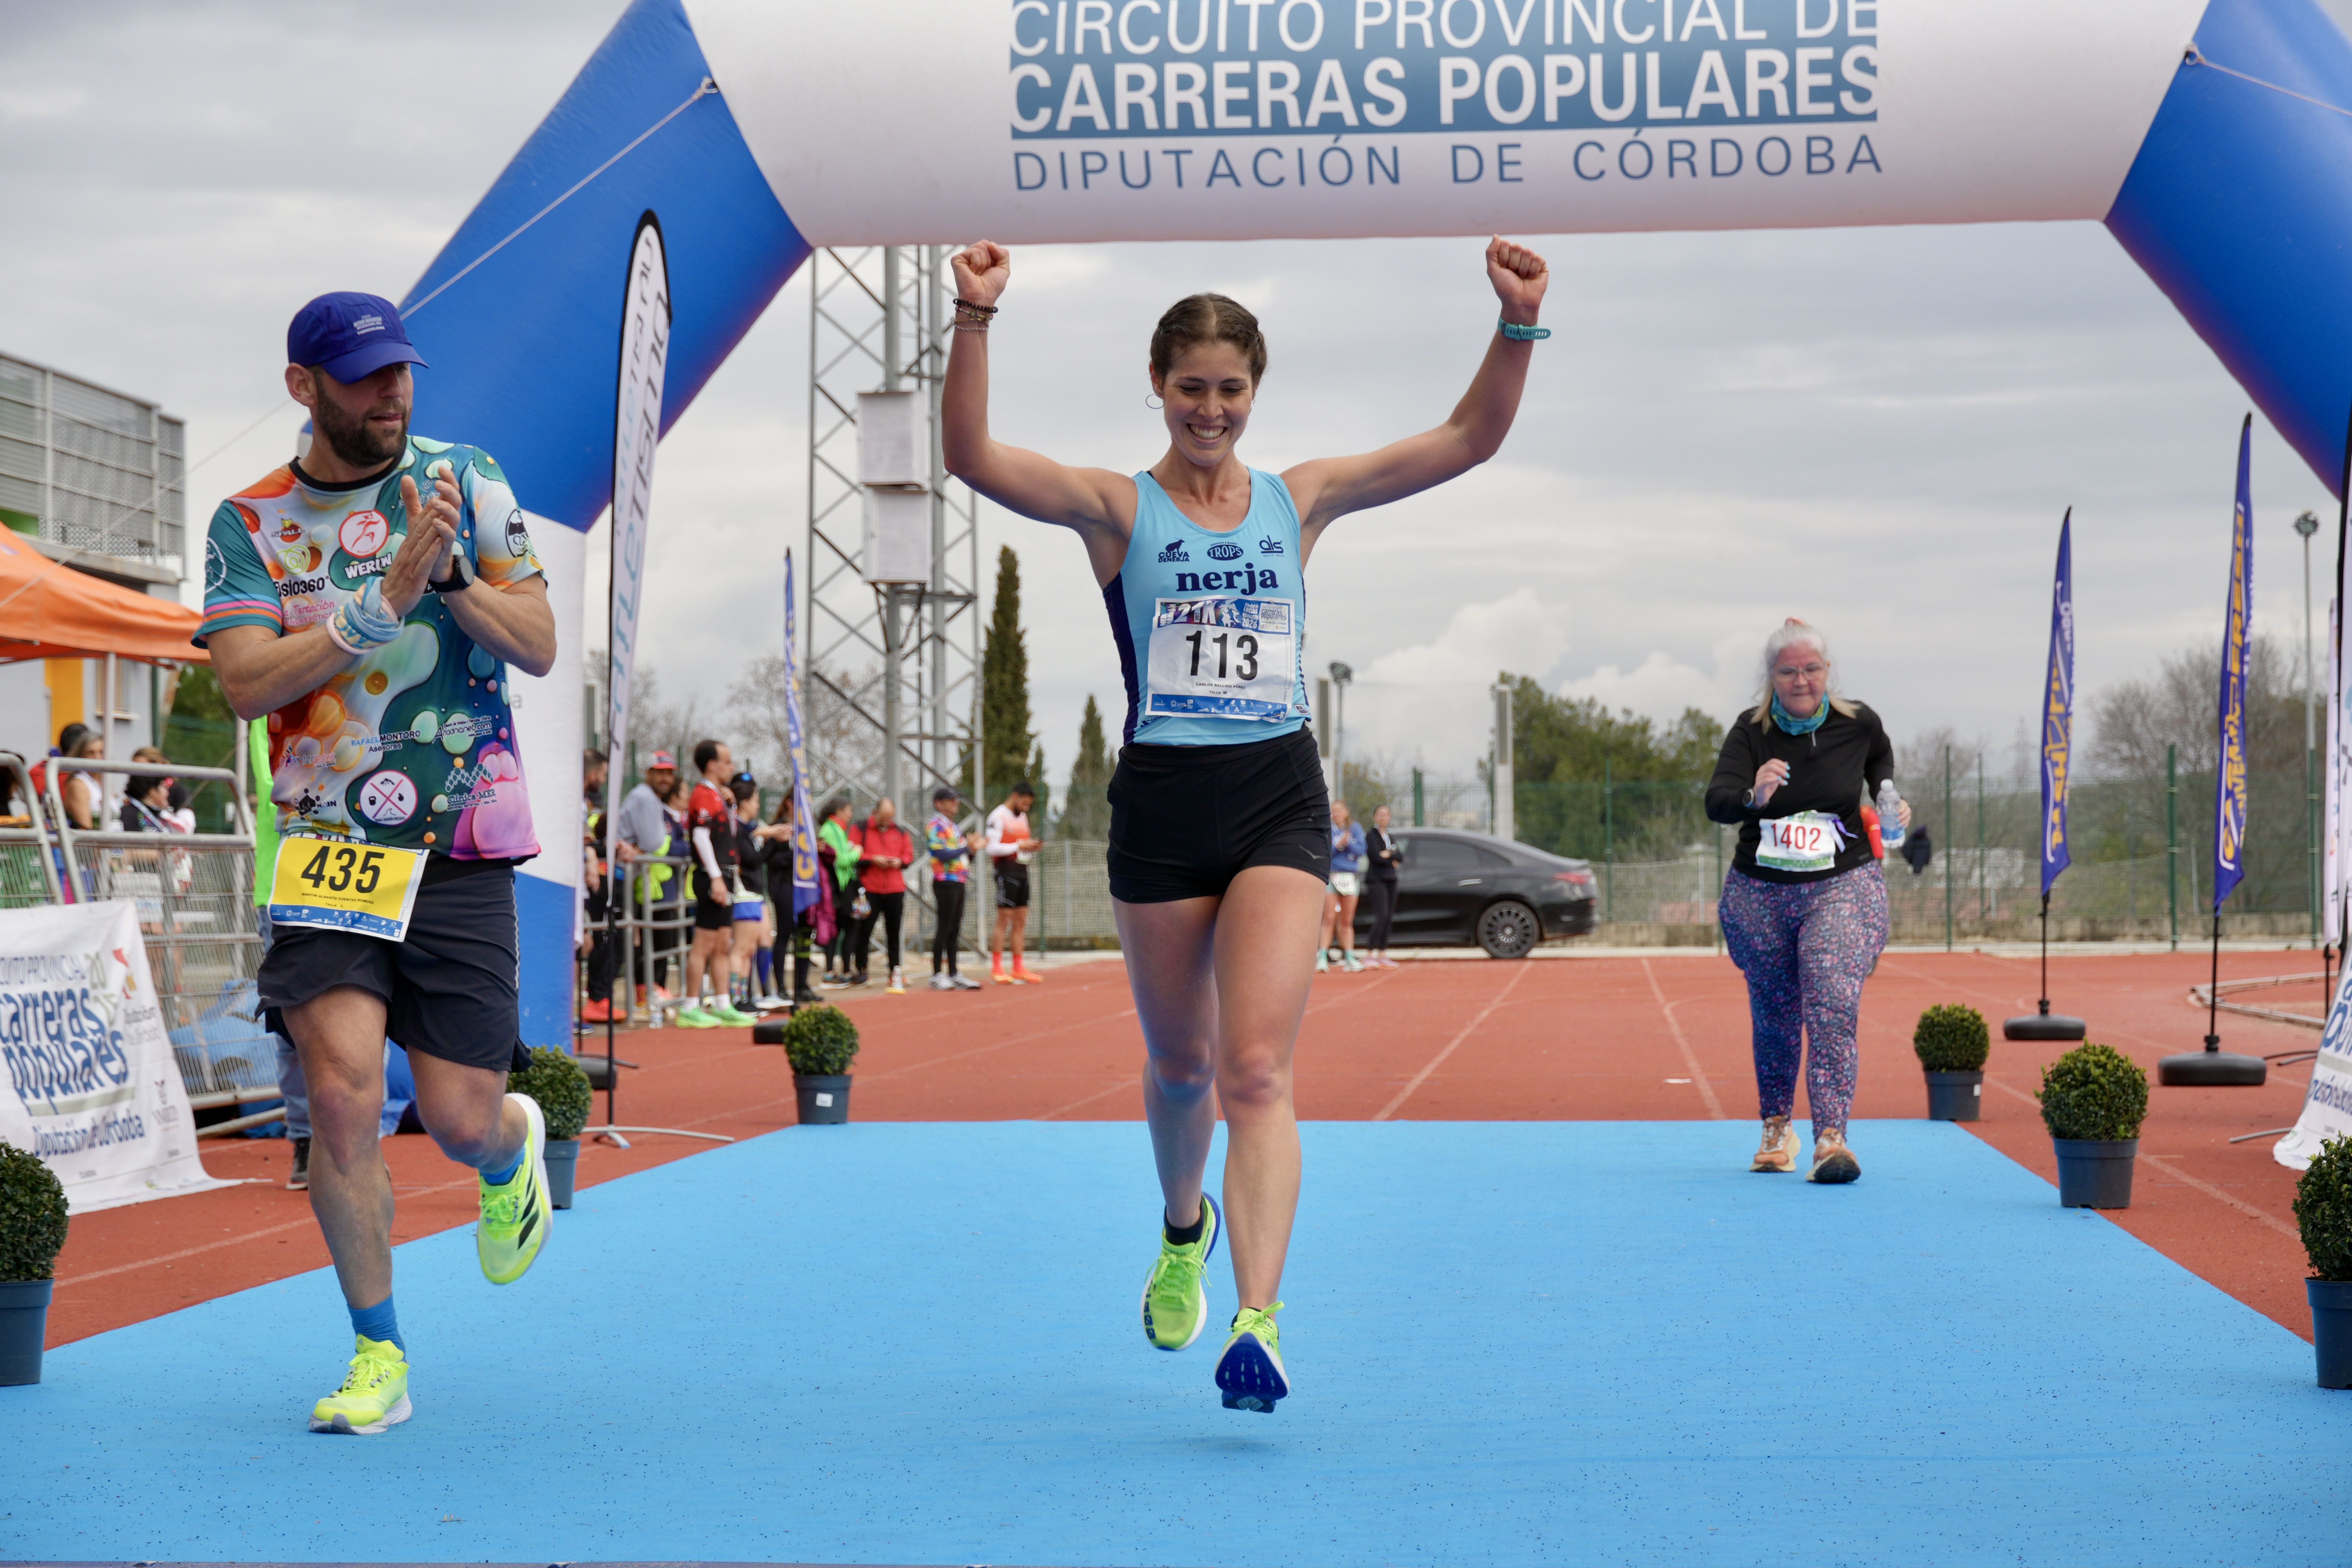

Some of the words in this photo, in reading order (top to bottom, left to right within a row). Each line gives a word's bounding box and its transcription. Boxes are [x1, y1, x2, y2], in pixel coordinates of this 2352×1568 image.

[1010, 0, 1324, 56] CIRCUITO
[1355, 0, 1767, 49] PROVINCIAL
[1796, 0, 1878, 39] DE
[1009, 58, 1408, 132] CARRERAS
[1440, 44, 1878, 125] POPULARES
[1013, 134, 1401, 191] DIPUTACIÓN
[1451, 143, 1523, 184] DE
[1573, 127, 1883, 181] CÓRDOBA
[1209, 547, 1243, 558] TROPS
[1175, 563, 1279, 595] nerja
[284, 617, 303, 626] ENDA
[293, 599, 335, 616] Tentación
[1242, 617, 1258, 629] 2026
[1186, 631, 1258, 681] 113
[368, 743, 402, 753] Asesores
[1771, 823, 1821, 851] 1402
[301, 846, 385, 893] 435
